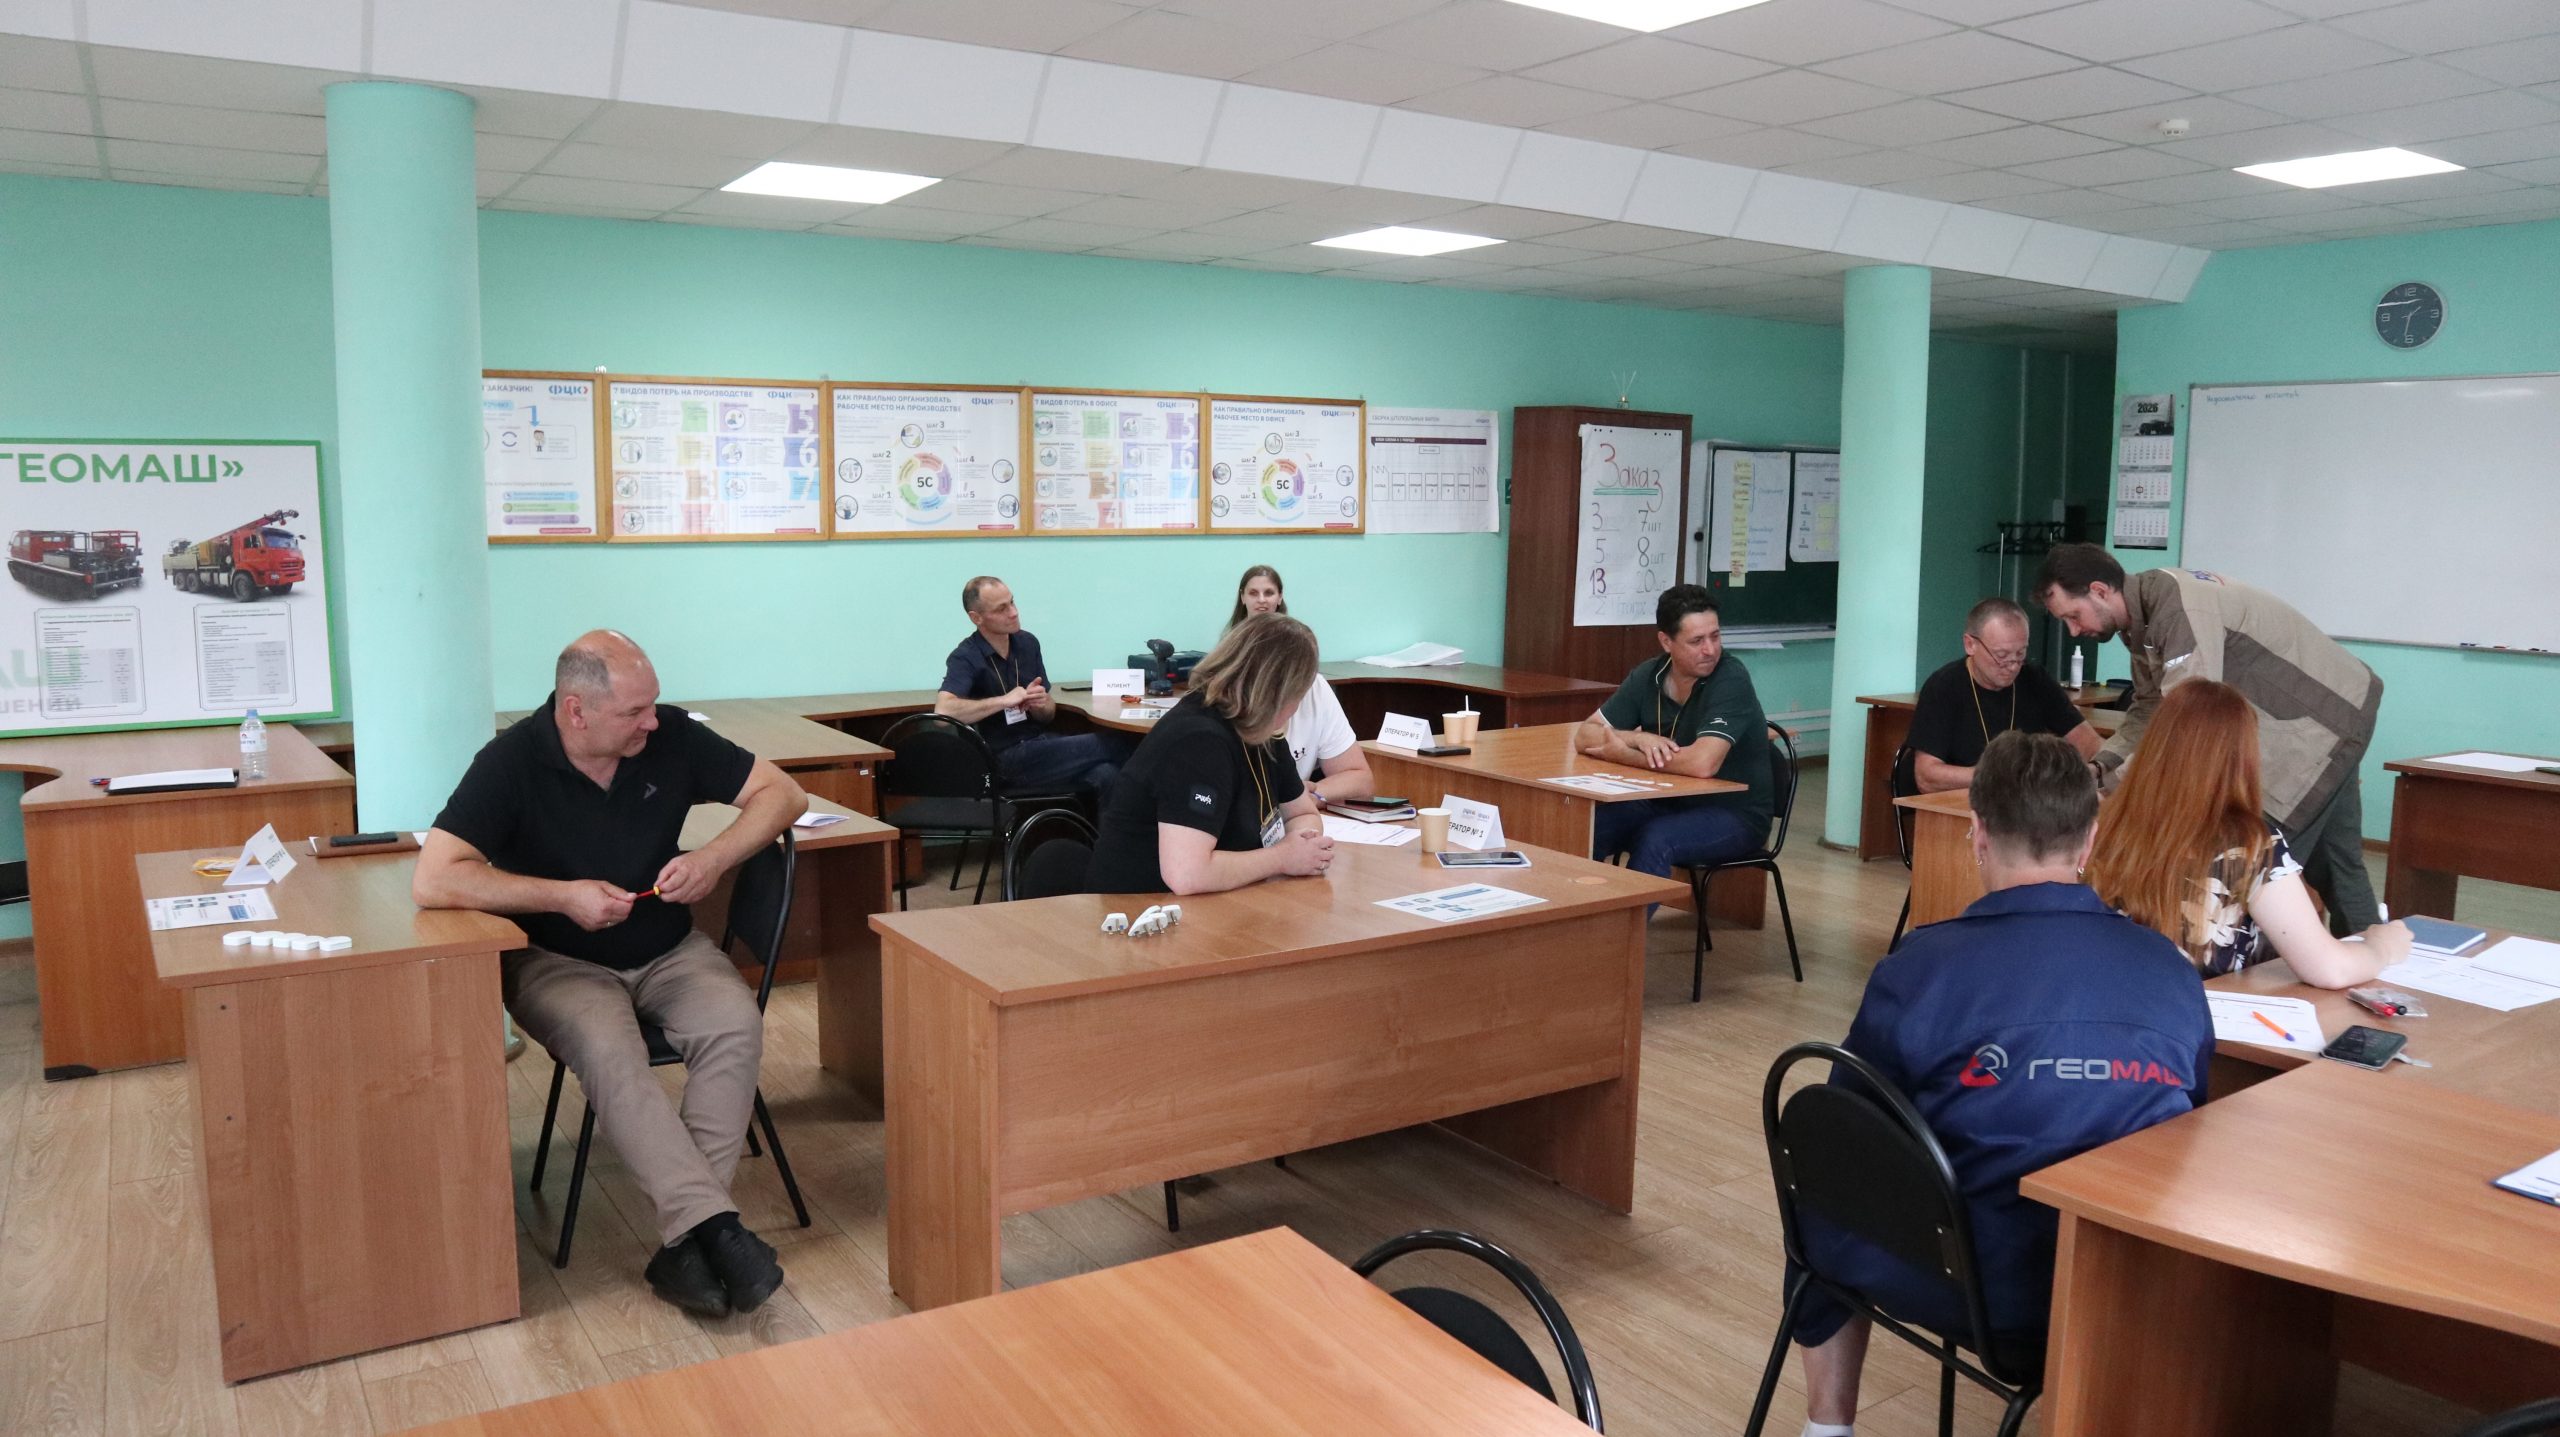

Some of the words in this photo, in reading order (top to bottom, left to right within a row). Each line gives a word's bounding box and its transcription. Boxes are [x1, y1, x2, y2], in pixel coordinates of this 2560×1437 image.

[2405, 287, 2416, 297] 12
[2381, 313, 2390, 322] 9
[2430, 309, 2440, 318] 3
[2404, 334, 2414, 344] 6
[650, 388, 680, 396] ПОТЕРЬ
[693, 389, 753, 398] ПРОИЗВОДСТВЕ
[898, 395, 952, 403] ОРГАНИЗОВАТЬ
[906, 405, 961, 413] ПРОИЗВОДСТВЕ
[1262, 408, 1305, 416] ОРГАНИЗОВАТЬ
[1598, 443, 1664, 513] Заказ
[1591, 502, 1603, 530] 3
[1589, 567, 1607, 596] 13
[1384, 727, 1410, 737] ОПЕРАТОР
[1448, 821, 1472, 834] ЕРАТОР
